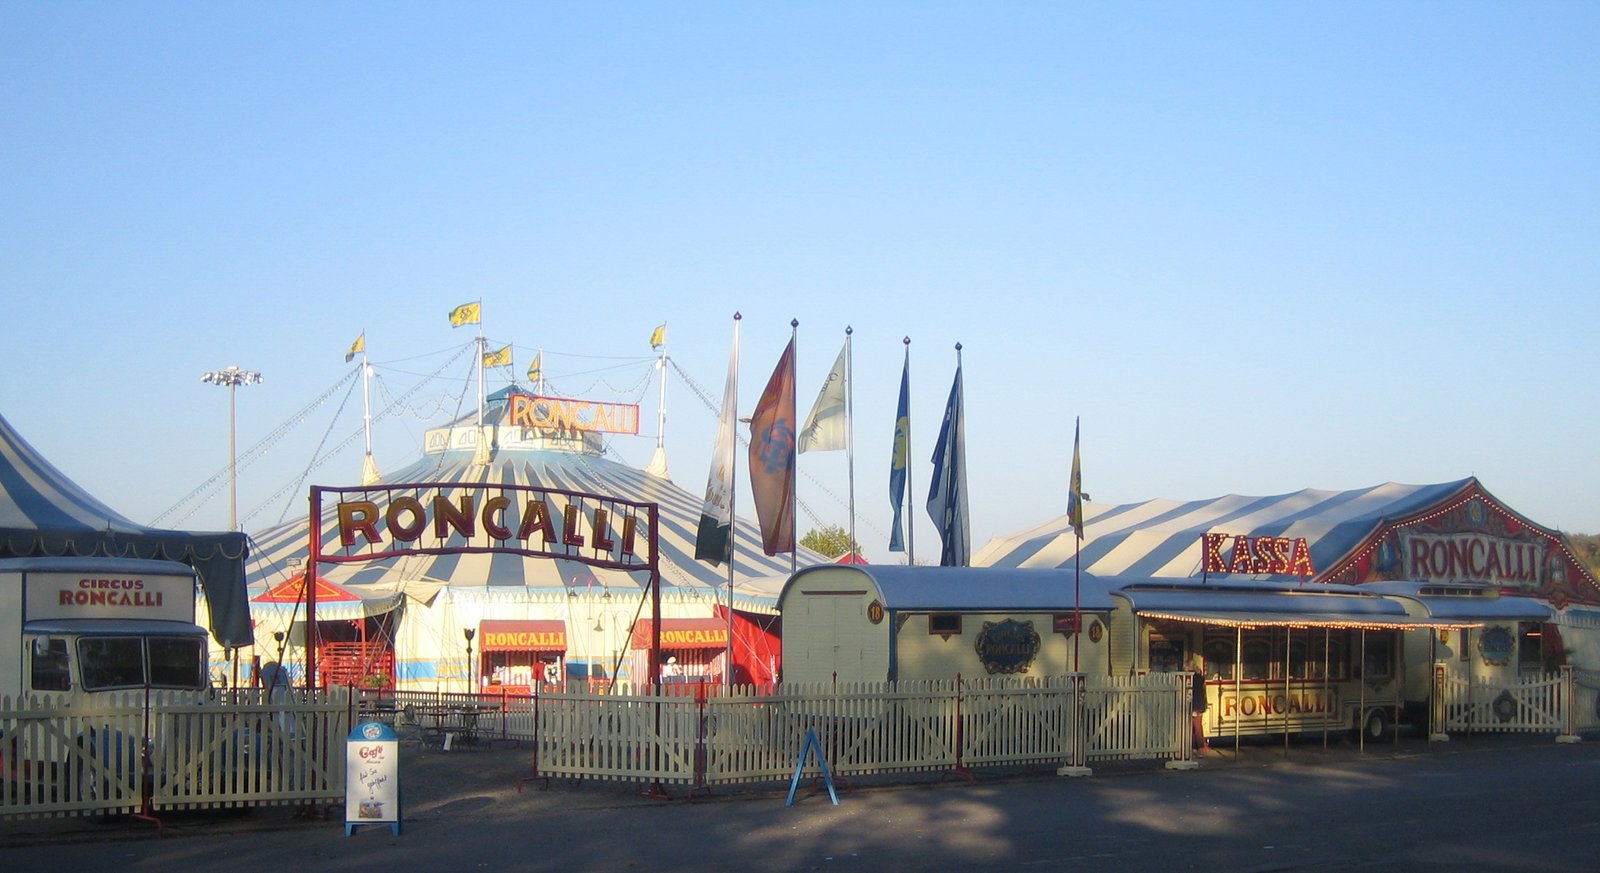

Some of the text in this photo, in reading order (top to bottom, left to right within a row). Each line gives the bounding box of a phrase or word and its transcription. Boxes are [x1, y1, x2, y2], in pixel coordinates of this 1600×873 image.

[513, 395, 636, 434] RONCALLI
[337, 494, 638, 556] RONCALLI
[1200, 533, 1315, 576] KASSA
[1408, 537, 1538, 581] RONCALLI
[79, 579, 144, 589] CIRCUS
[59, 590, 162, 606] RONCALLI
[869, 606, 881, 620] 18
[485, 632, 564, 646] RONCALLI
[1224, 695, 1332, 717] RONCALLI
